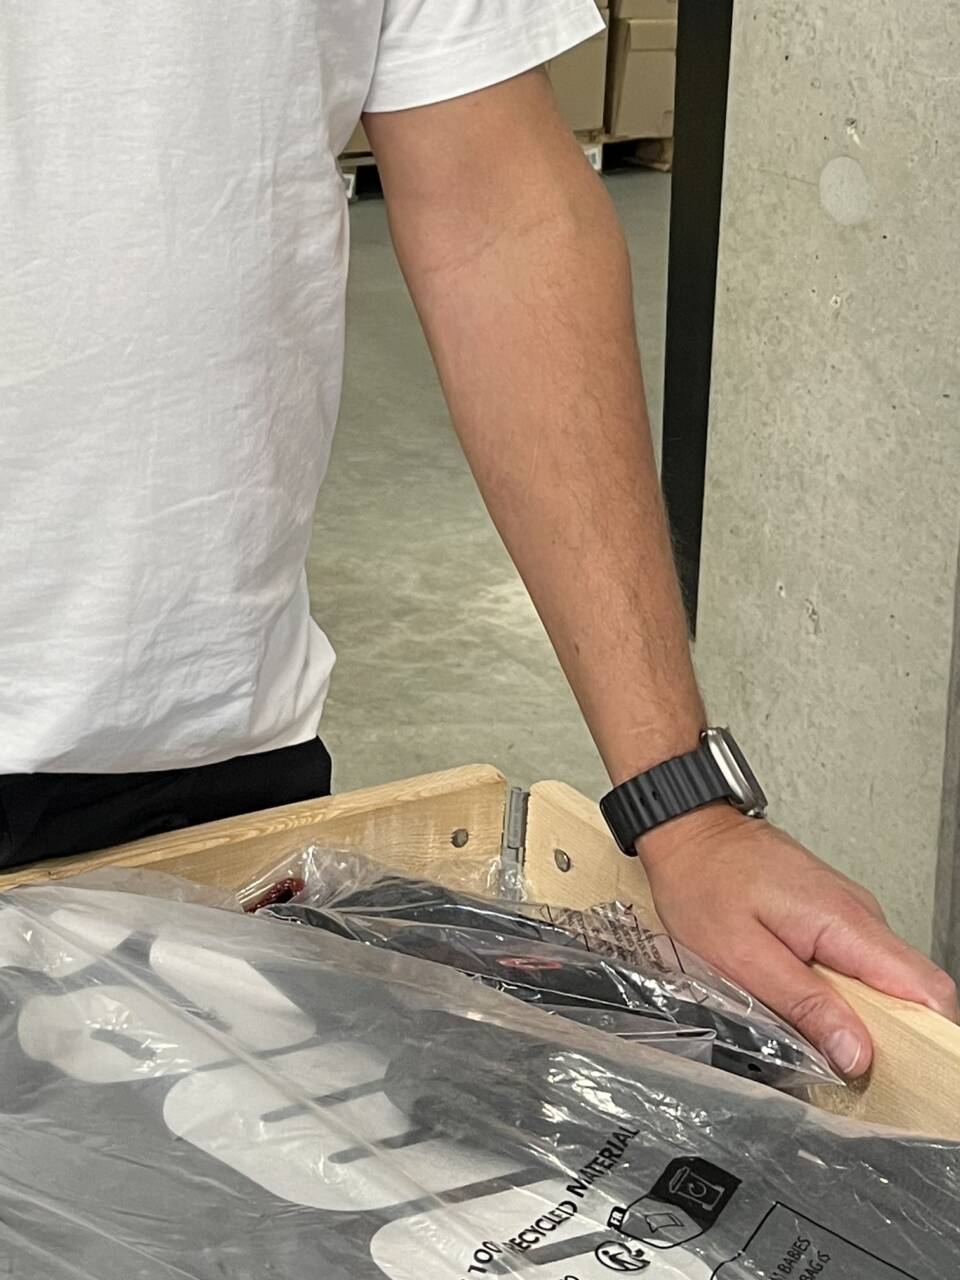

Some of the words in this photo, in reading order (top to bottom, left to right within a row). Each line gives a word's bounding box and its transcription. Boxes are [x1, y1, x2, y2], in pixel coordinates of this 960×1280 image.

[502, 1200, 578, 1255] RECYCLED
[566, 1126, 641, 1198] MATERIAL
[777, 1236, 811, 1274] BABIES
